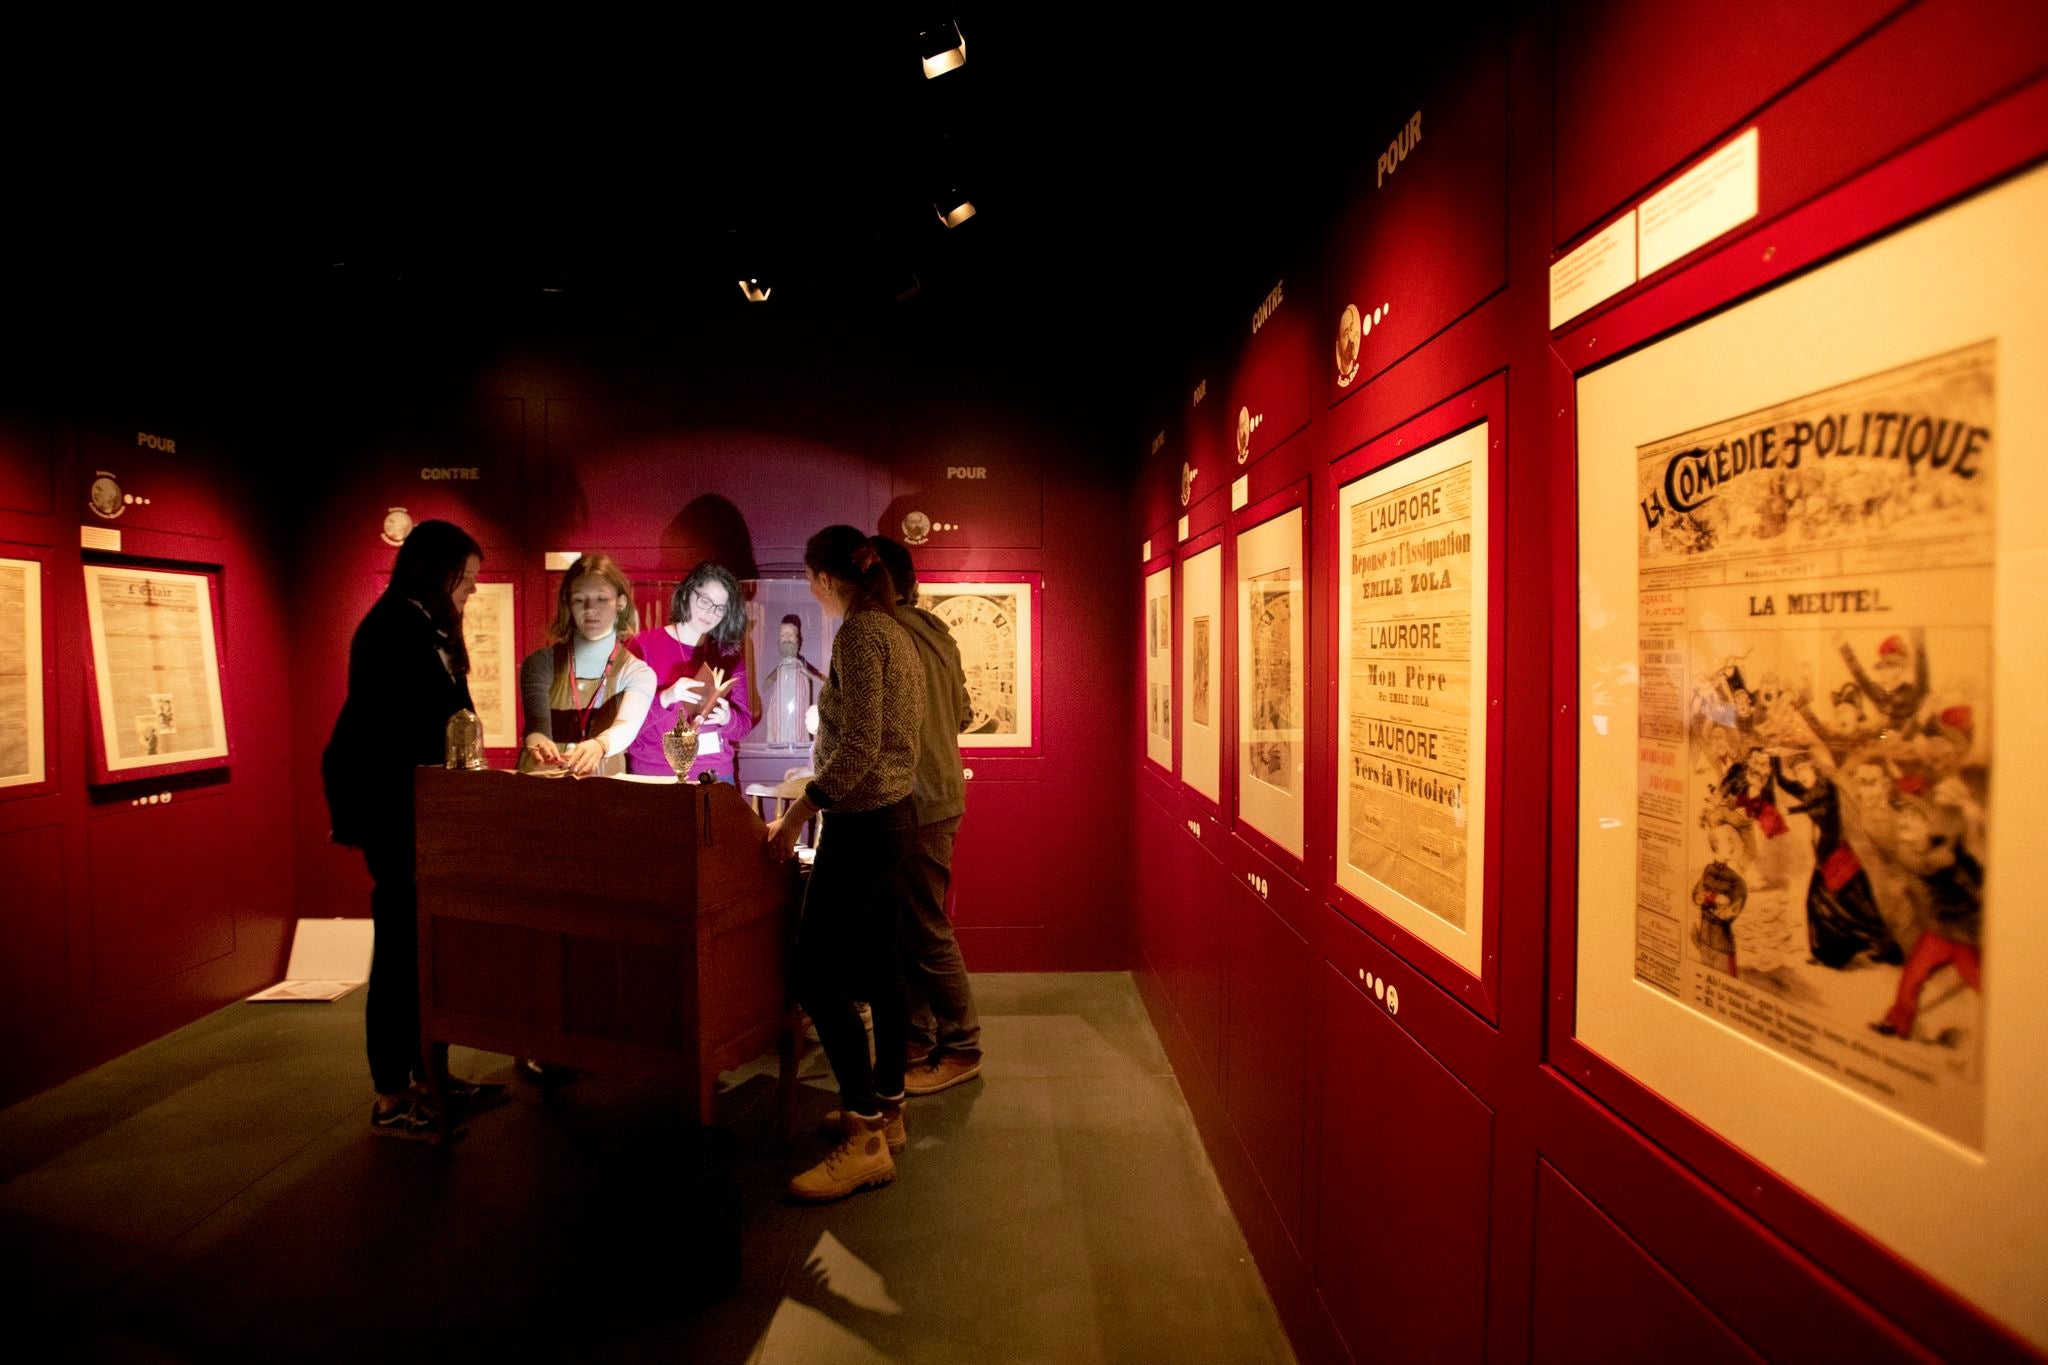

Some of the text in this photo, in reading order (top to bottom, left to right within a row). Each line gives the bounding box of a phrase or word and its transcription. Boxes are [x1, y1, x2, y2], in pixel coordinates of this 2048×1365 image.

[1377, 110, 1422, 188] POUR
[1253, 279, 1284, 334] CONTRE
[137, 432, 176, 454] POUR
[421, 468, 480, 480] CONTRE
[947, 467, 987, 479] POUR
[1640, 411, 1990, 531] LA COMÉDIE POLITIQUE
[1370, 487, 1442, 533] L'AURORE
[1411, 569, 1452, 593] ZOLA
[1750, 595, 1776, 616] LA
[1370, 622, 1442, 649] L'AURORE
[1368, 664, 1447, 691] Mon Père
[1412, 695, 1429, 707] ZOLA
[1368, 723, 1438, 760] L'AURORE
[1355, 757, 1379, 783] Vers
[1382, 764, 1393, 787] la
